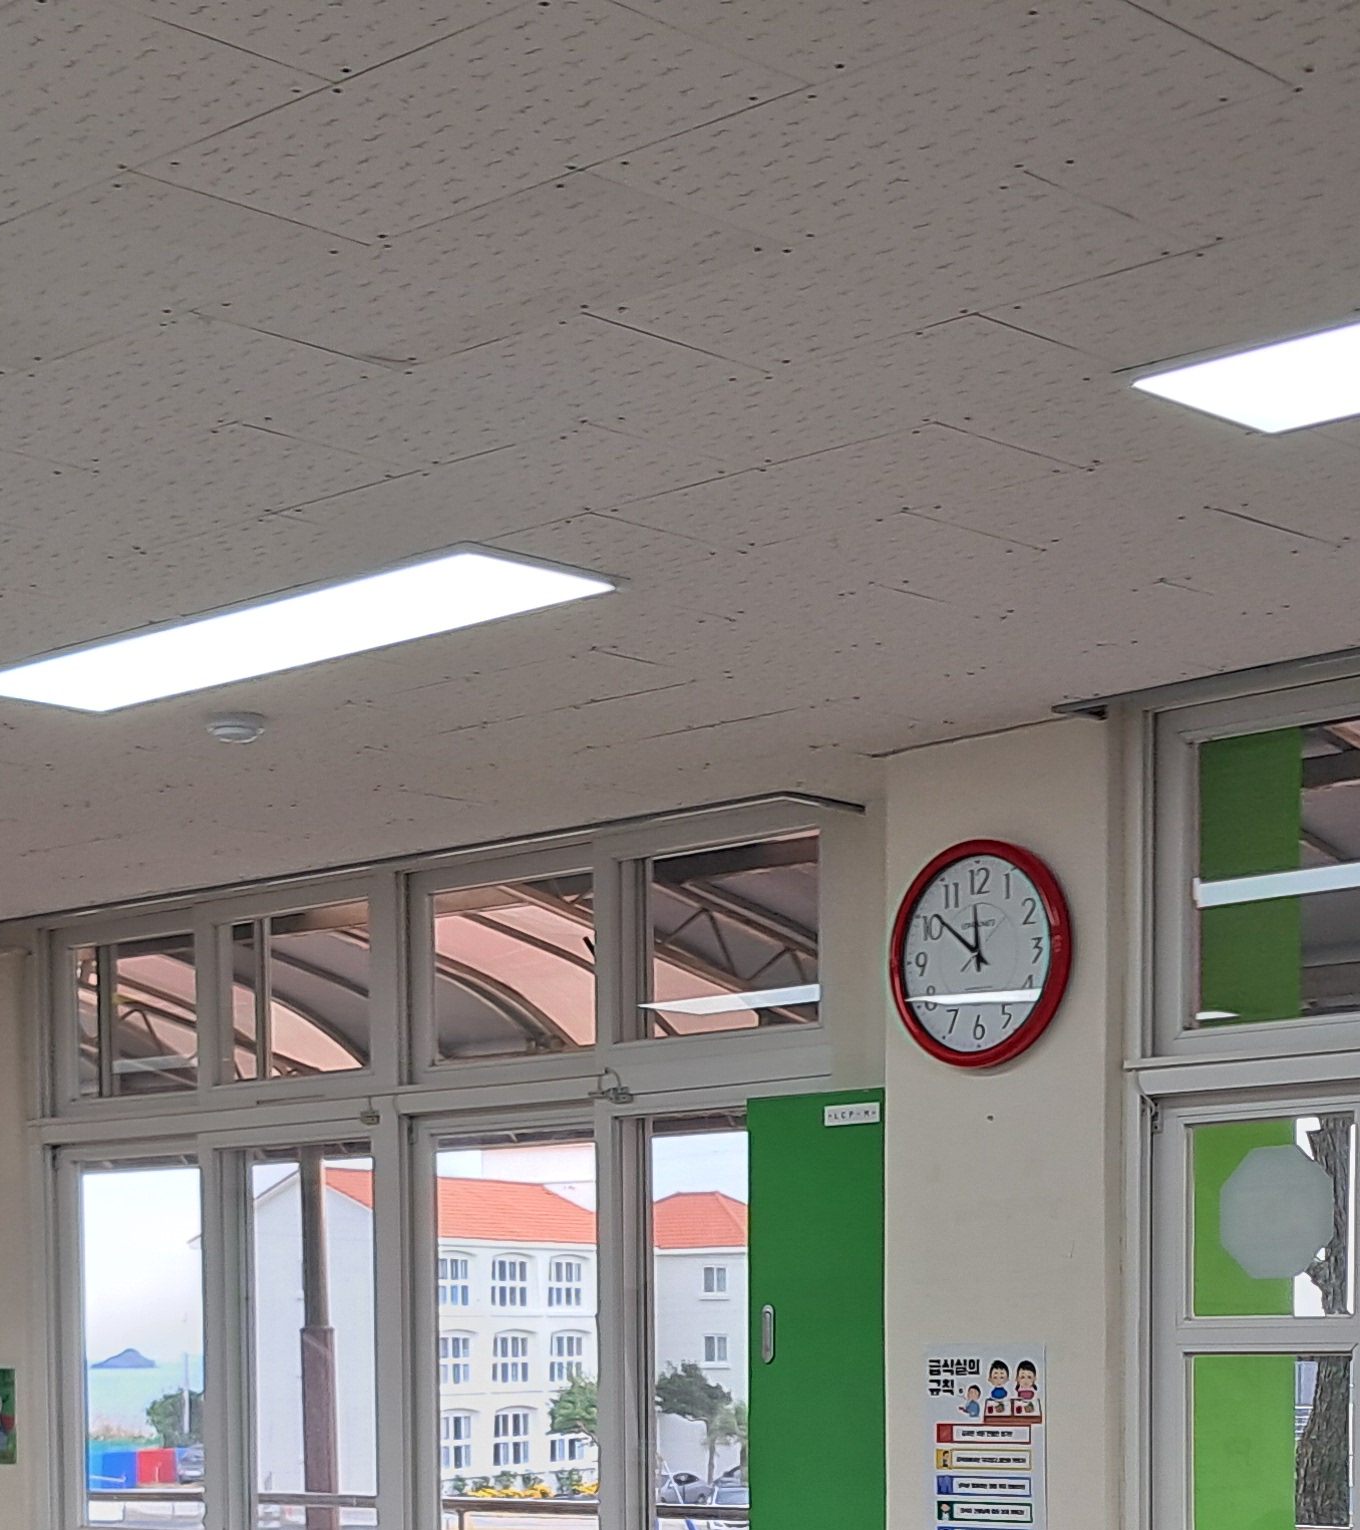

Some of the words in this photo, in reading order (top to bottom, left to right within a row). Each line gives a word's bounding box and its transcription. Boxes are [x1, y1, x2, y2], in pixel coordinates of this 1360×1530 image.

[969, 868, 990, 895] 12
[1004, 873, 1011, 899] 1
[944, 882, 959, 909] 11
[1021, 898, 1036, 925] 2
[923, 915, 943, 941] 10
[915, 951, 928, 977] 9
[1031, 938, 1043, 964] 3
[946, 1009, 959, 1034] 7
[973, 1015, 986, 1040] 6
[1001, 1004, 1013, 1029] 5
[928, 1359, 980, 1376] 급식실의
[928, 1379, 955, 1396] 규칙
